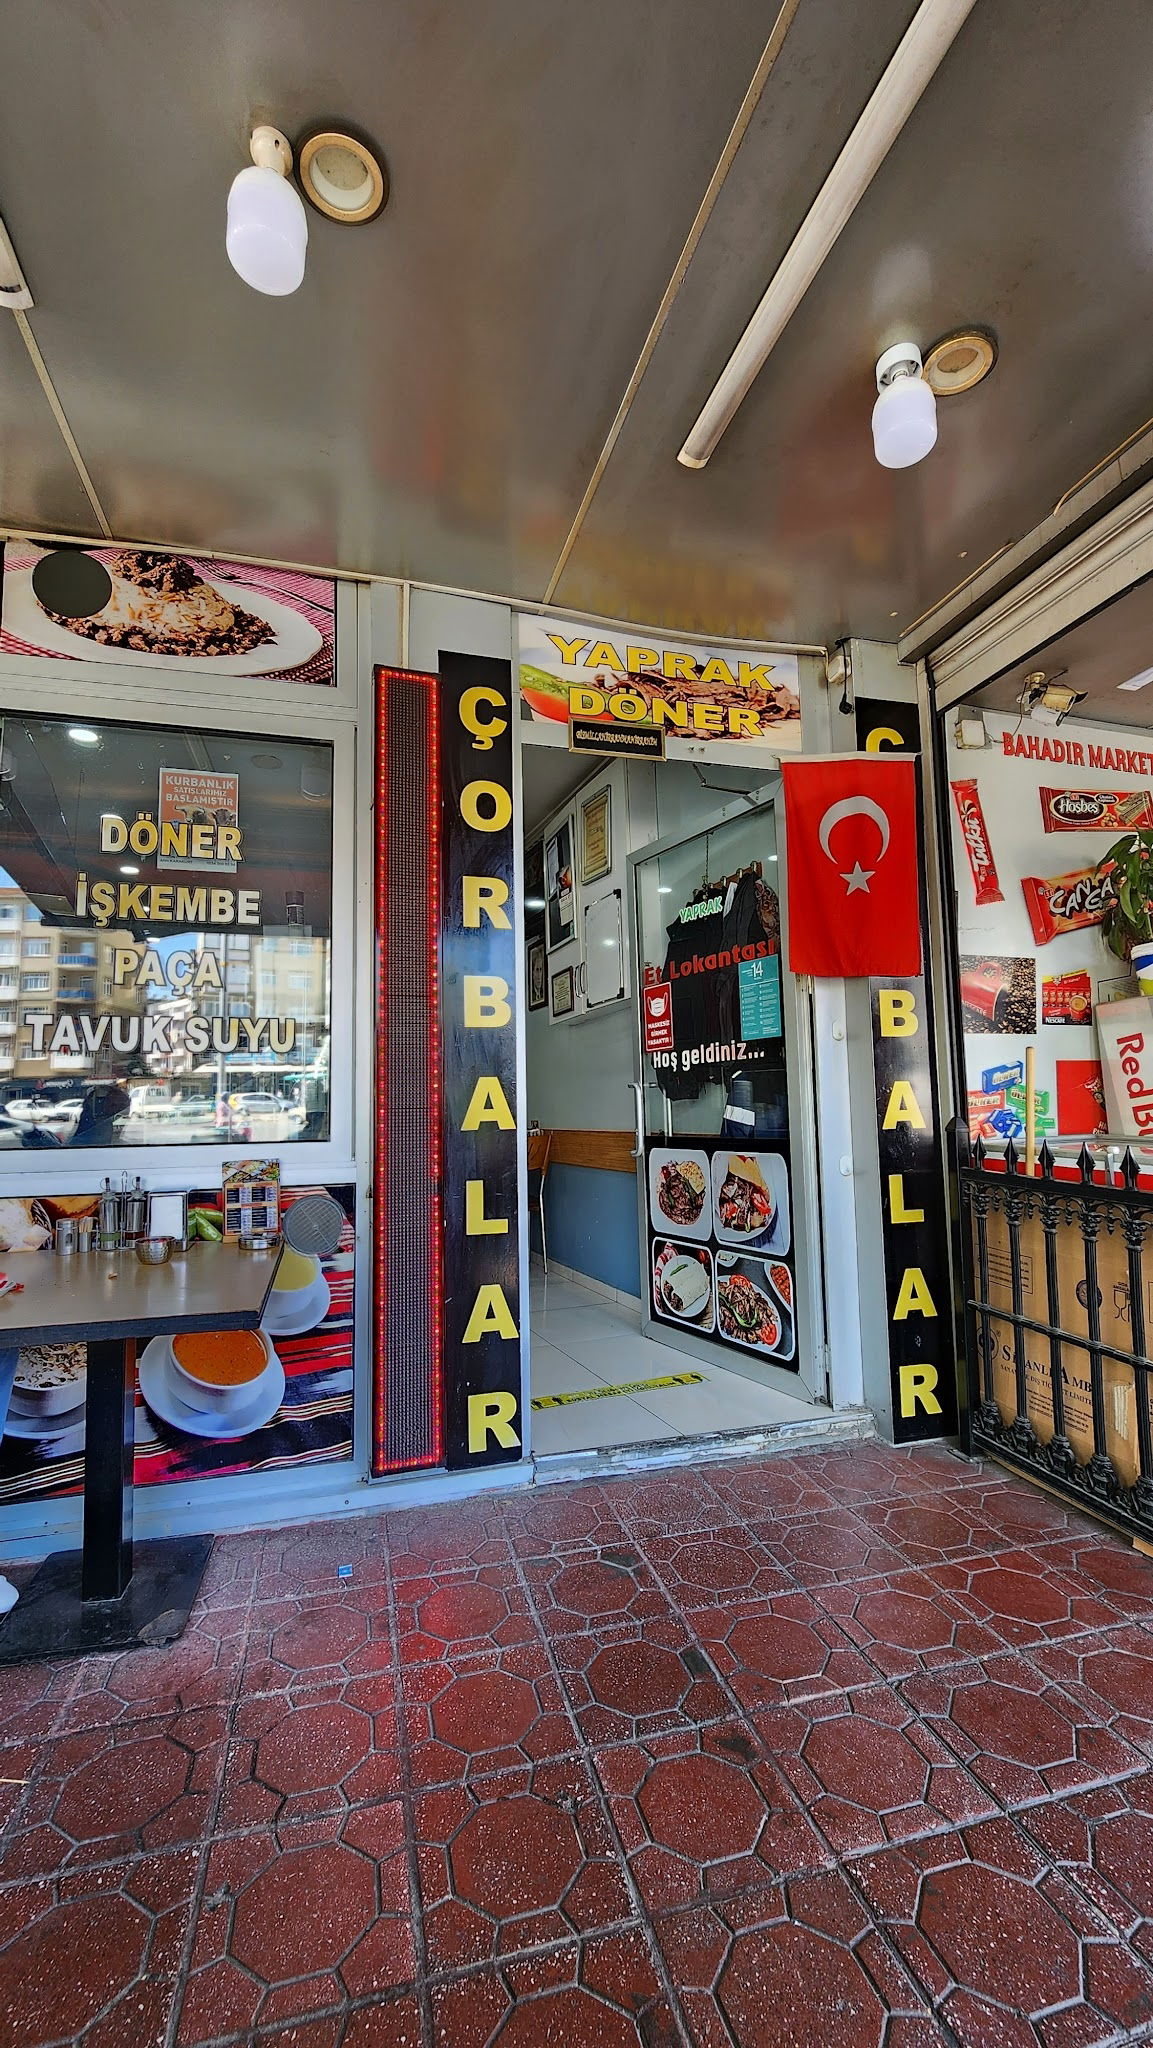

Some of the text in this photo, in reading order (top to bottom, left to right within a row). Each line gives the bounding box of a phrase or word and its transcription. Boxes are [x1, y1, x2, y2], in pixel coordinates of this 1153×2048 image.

[546, 632, 779, 691] YAPRAK
[568, 686, 766, 737] DÖNER
[1002, 731, 1085, 766] BAHADIR
[166, 775, 234, 790] KURBANLIK
[99, 811, 246, 864] DÖNER
[75, 871, 263, 927] İŞKEMBE
[679, 896, 723, 923] YAPRAK
[1049, 876, 1115, 917] CANGA
[112, 948, 226, 996] PAÇA
[643, 939, 776, 986] Et Lokantası
[751, 961, 764, 978] 14
[25, 1014, 297, 1055] TAVUK SUYU
[653, 1050, 678, 1072] Hoş
